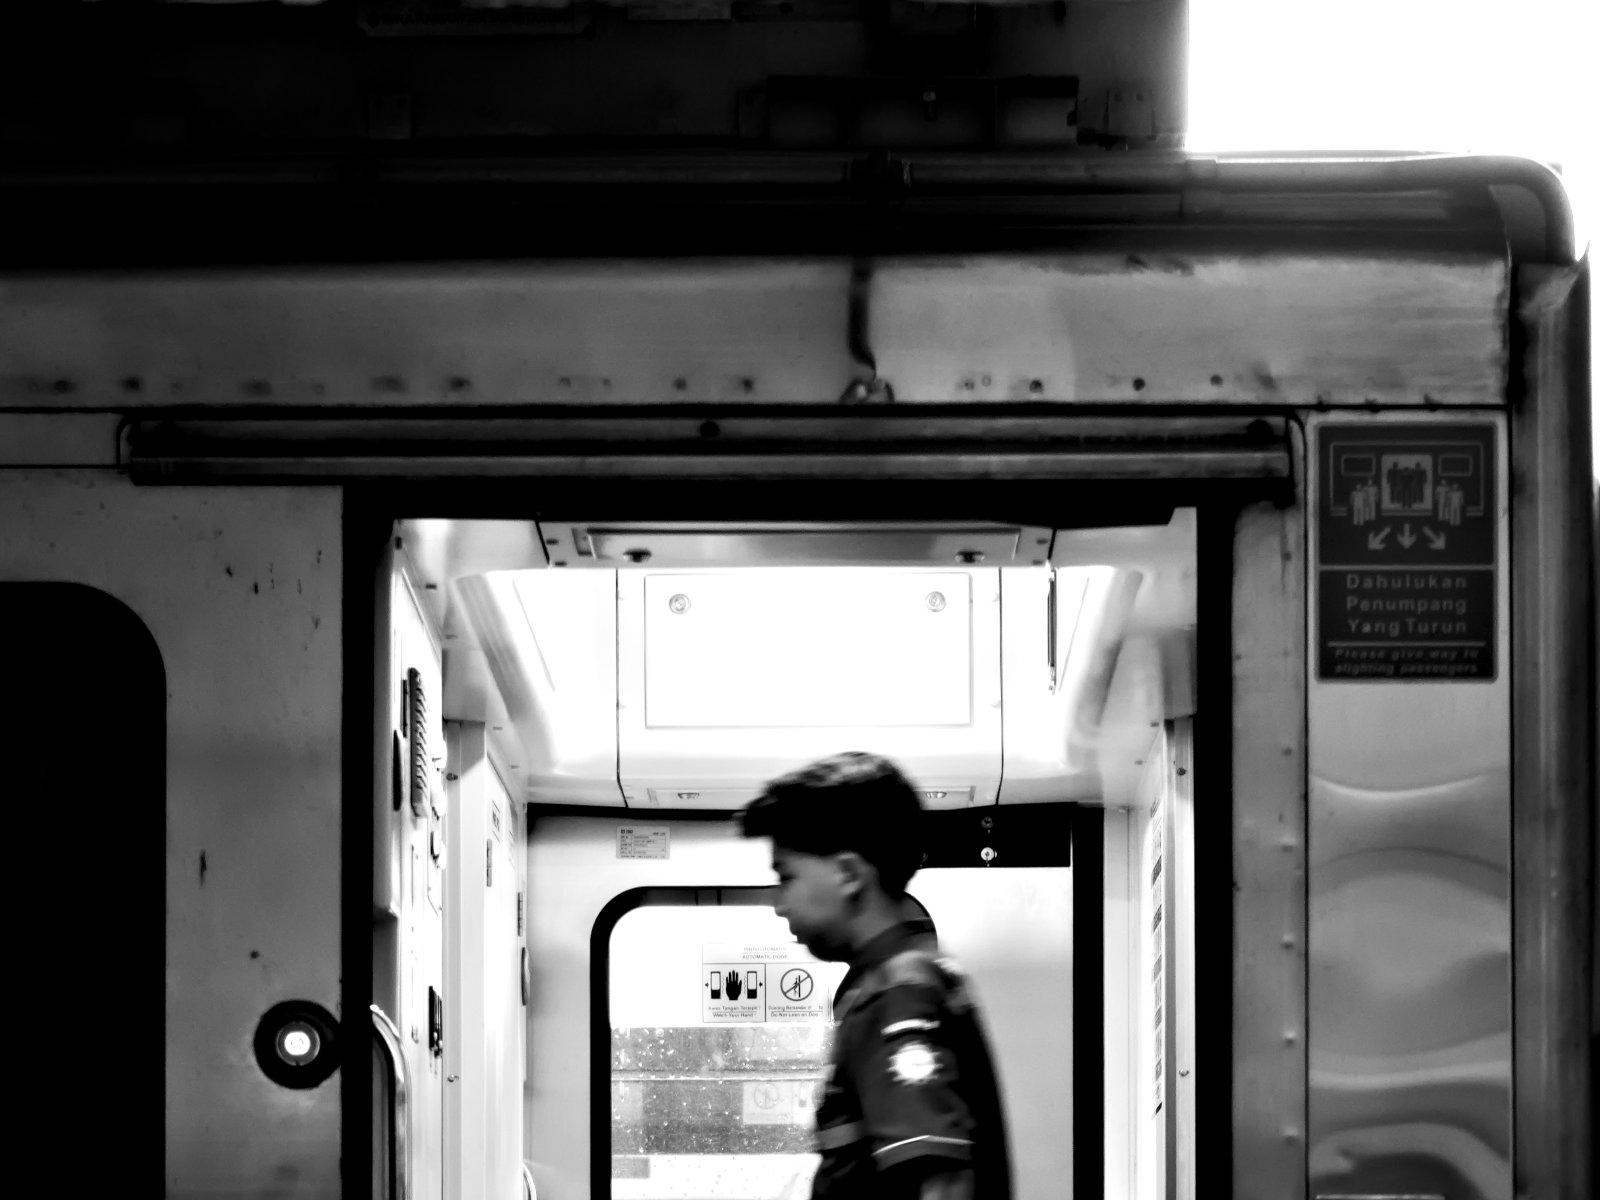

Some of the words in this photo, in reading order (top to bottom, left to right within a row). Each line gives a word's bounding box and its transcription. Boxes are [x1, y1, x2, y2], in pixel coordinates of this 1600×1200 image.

[1346, 574, 1467, 589] Dahulukan
[1346, 596, 1467, 615] Penumpang
[1347, 618, 1400, 637] Yang
[1405, 618, 1467, 633] Turun
[1391, 649, 1424, 661] give
[1430, 649, 1458, 661] way
